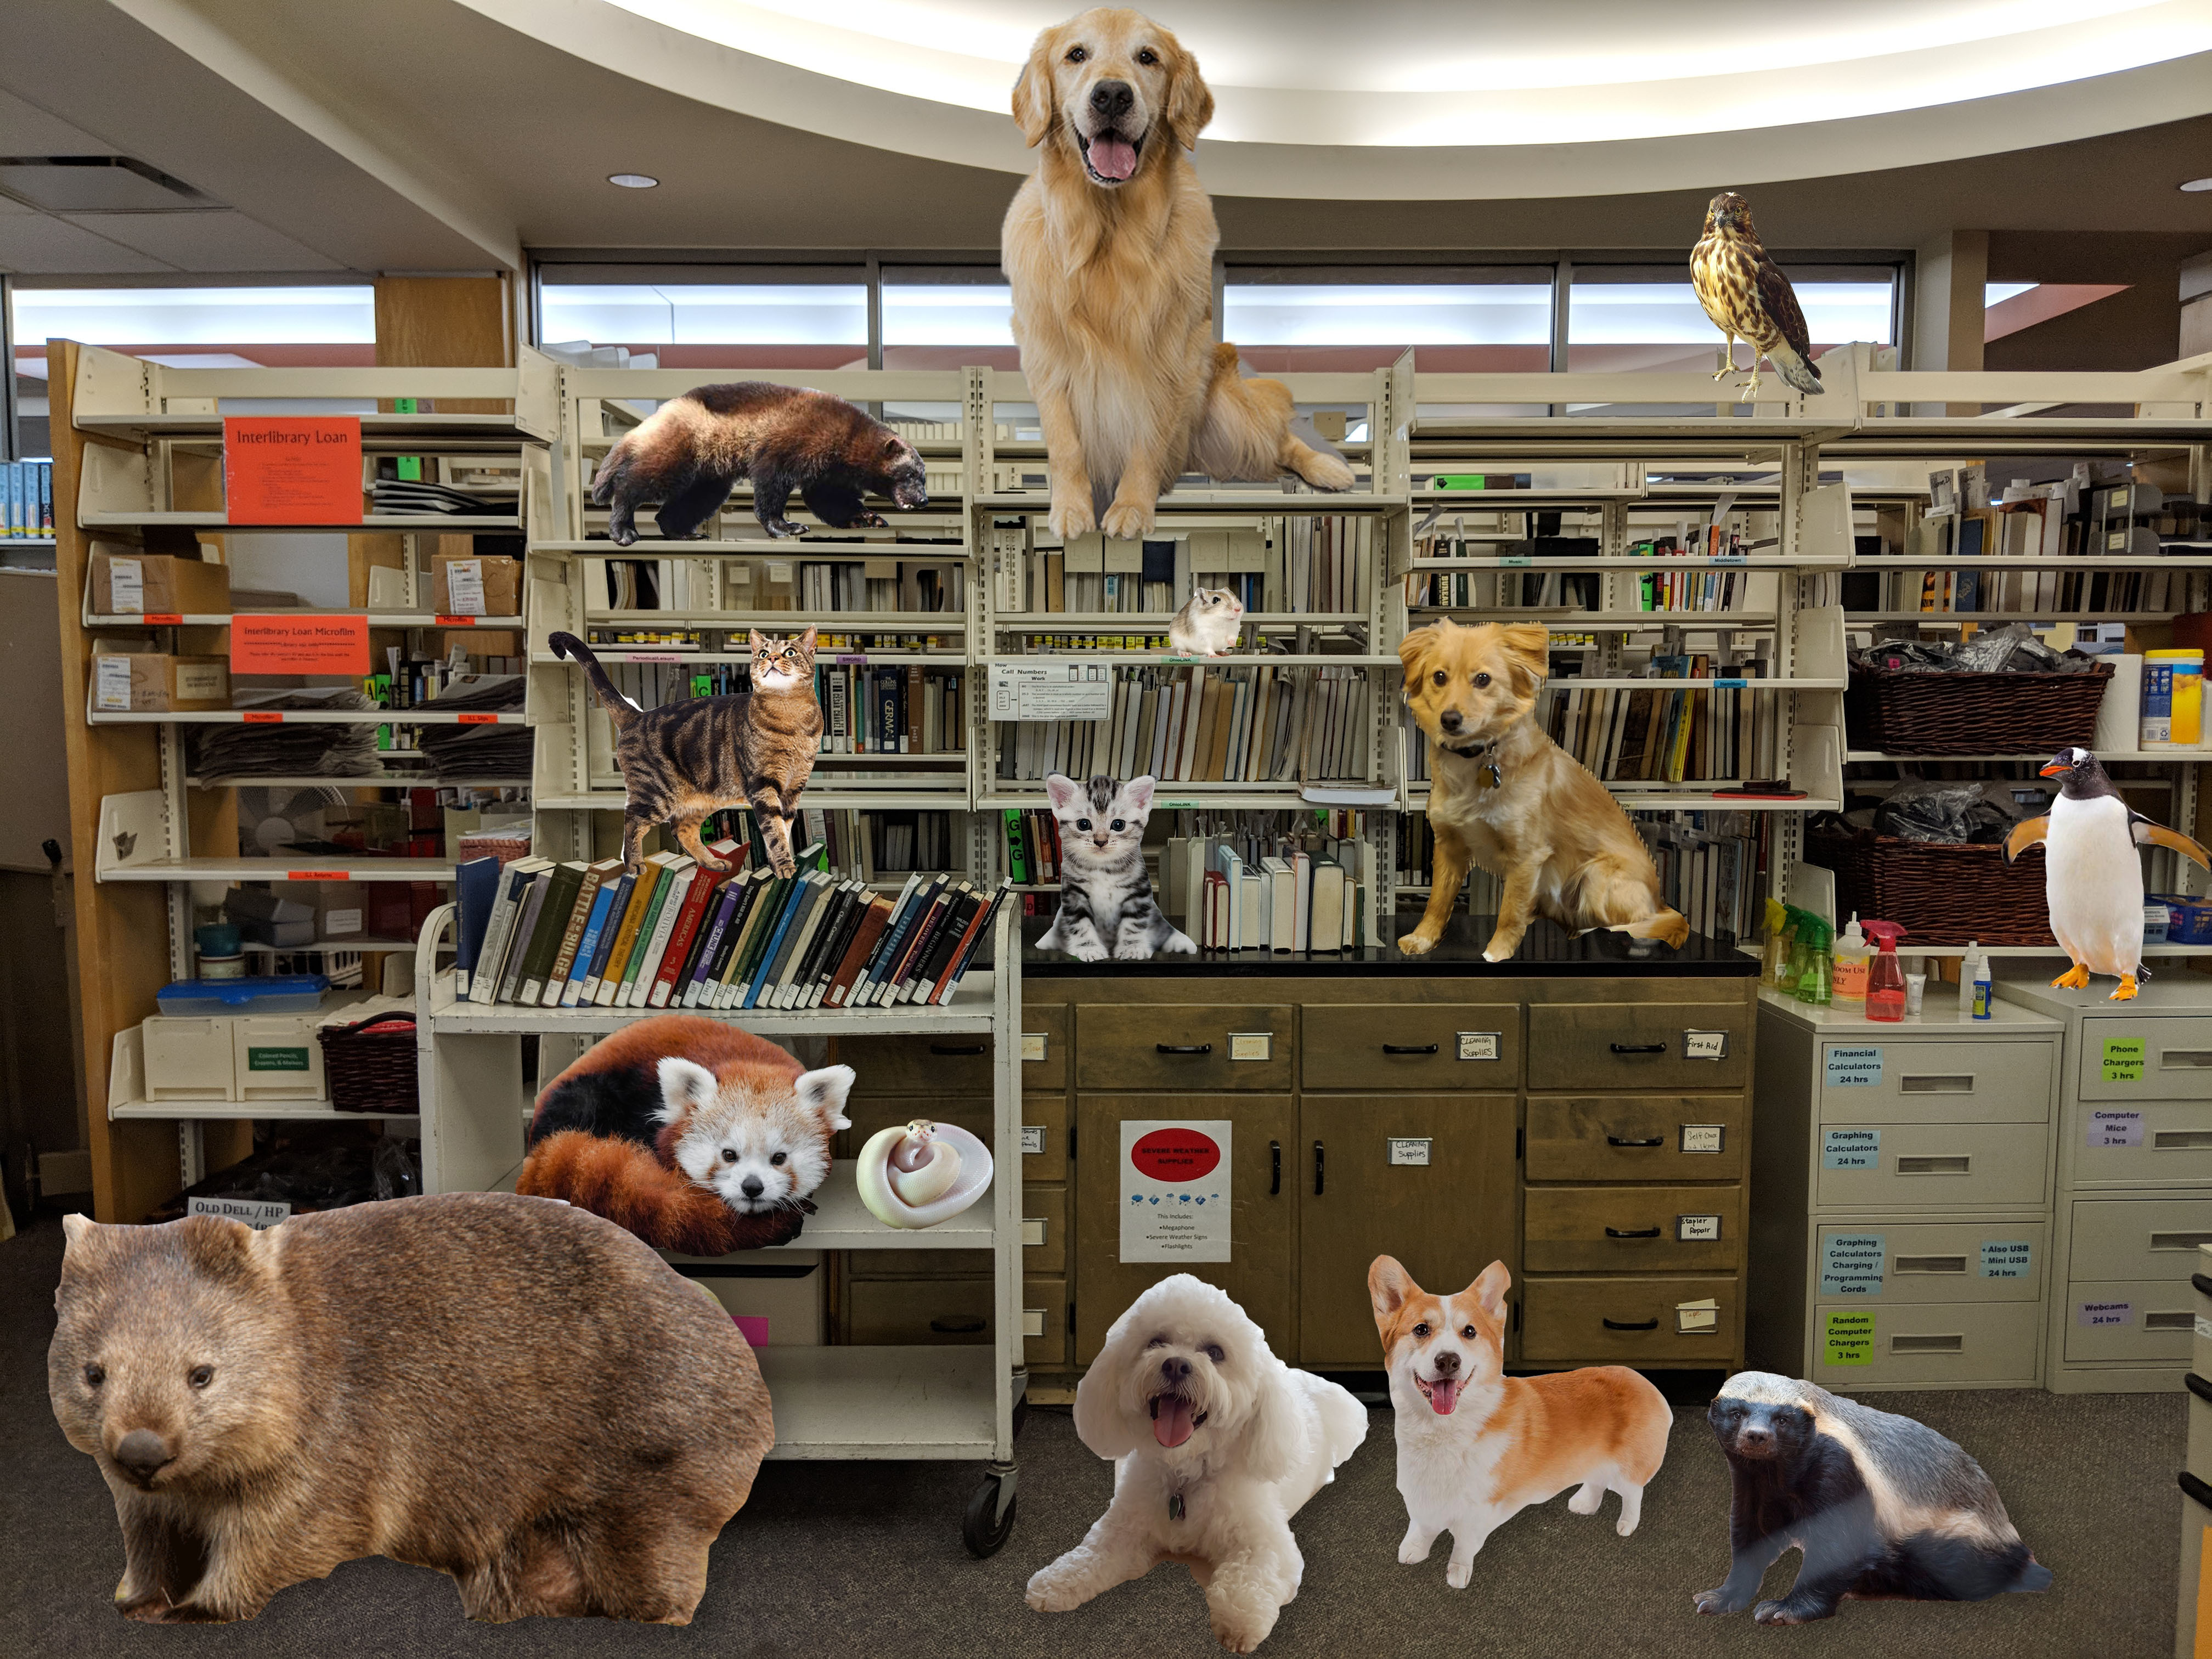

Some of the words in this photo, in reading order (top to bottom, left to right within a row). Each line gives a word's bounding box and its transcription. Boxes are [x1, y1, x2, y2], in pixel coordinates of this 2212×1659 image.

[238, 430, 310, 445] Interlibrary
[316, 430, 347, 443] Loan
[1414, 589, 1420, 598] L
[245, 628, 289, 636] Interlibrary
[379, 682, 390, 694] A
[699, 686, 709, 697] C
[1009, 820, 1020, 831] G
[1012, 849, 1023, 860] G
[746, 884, 754, 895] They
[571, 871, 599, 924] BATTLE
[628, 898, 642, 925] AFRICANA
[834, 910, 845, 924] Class
[646, 910, 657, 929] AMERICA
[657, 907, 674, 939] BOLIVIA
[939, 914, 949, 928] Carver
[955, 916, 969, 926] WALDEN
[675, 907, 696, 947] AMERICAS
[916, 915, 936, 945] BELOVED
[620, 924, 633, 947] CRITICAL
[707, 926, 723, 951] CRUNK
[826, 925, 838, 943] Canon
[554, 931, 579, 976] BULGE
[613, 947, 625, 968] THEORY
[909, 949, 918, 962] Toni
[914, 930, 941, 973] BEGINNERS
[895, 961, 911, 984] Morrison
[1706, 1042, 1718, 1051] Aid
[1688, 1131, 1702, 1141] Self
[1832, 1131, 1873, 1140] Graphing
[1396, 1141, 1426, 1149] CLEANING
[195, 1201, 219, 1214] OLD
[223, 1204, 252, 1215] DELL
[255, 1206, 262, 1219] /
[264, 1206, 284, 1217] HP
[1690, 1227, 1711, 1236] Repair
[1824, 1274, 1883, 1283] Programming
[2085, 1303, 2128, 1311] Webcams
[1684, 1311, 1701, 1319] Tape
